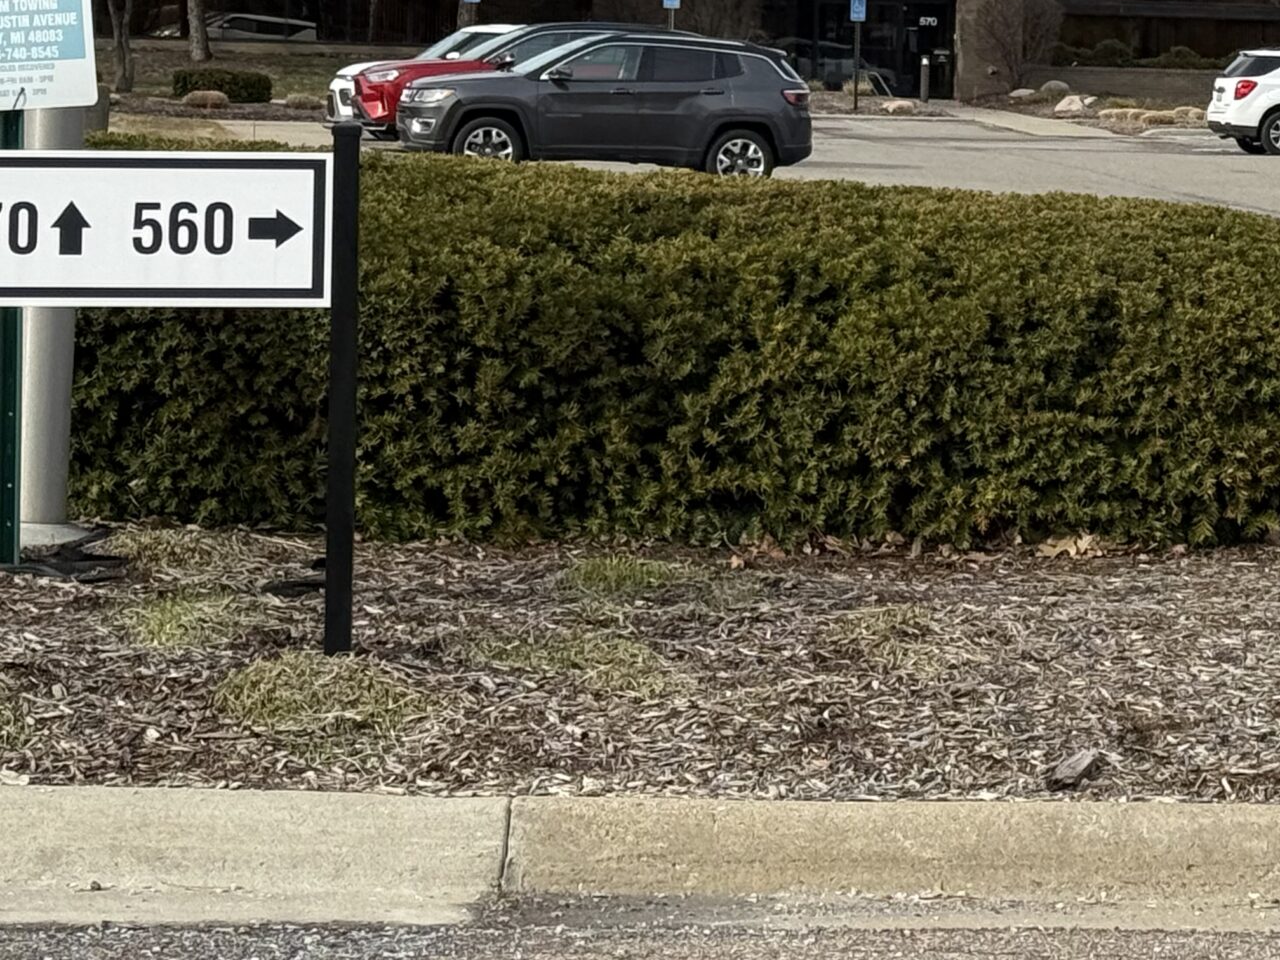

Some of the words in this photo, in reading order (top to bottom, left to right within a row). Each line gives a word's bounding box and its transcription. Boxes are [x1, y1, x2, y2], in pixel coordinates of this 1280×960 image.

[33, 12, 77, 27] AVENUE
[919, 16, 938, 26] 570
[10, 30, 25, 44] MI
[0, 45, 59, 60] -740-8545
[0, 201, 38, 255] 0
[132, 201, 234, 256] 560
